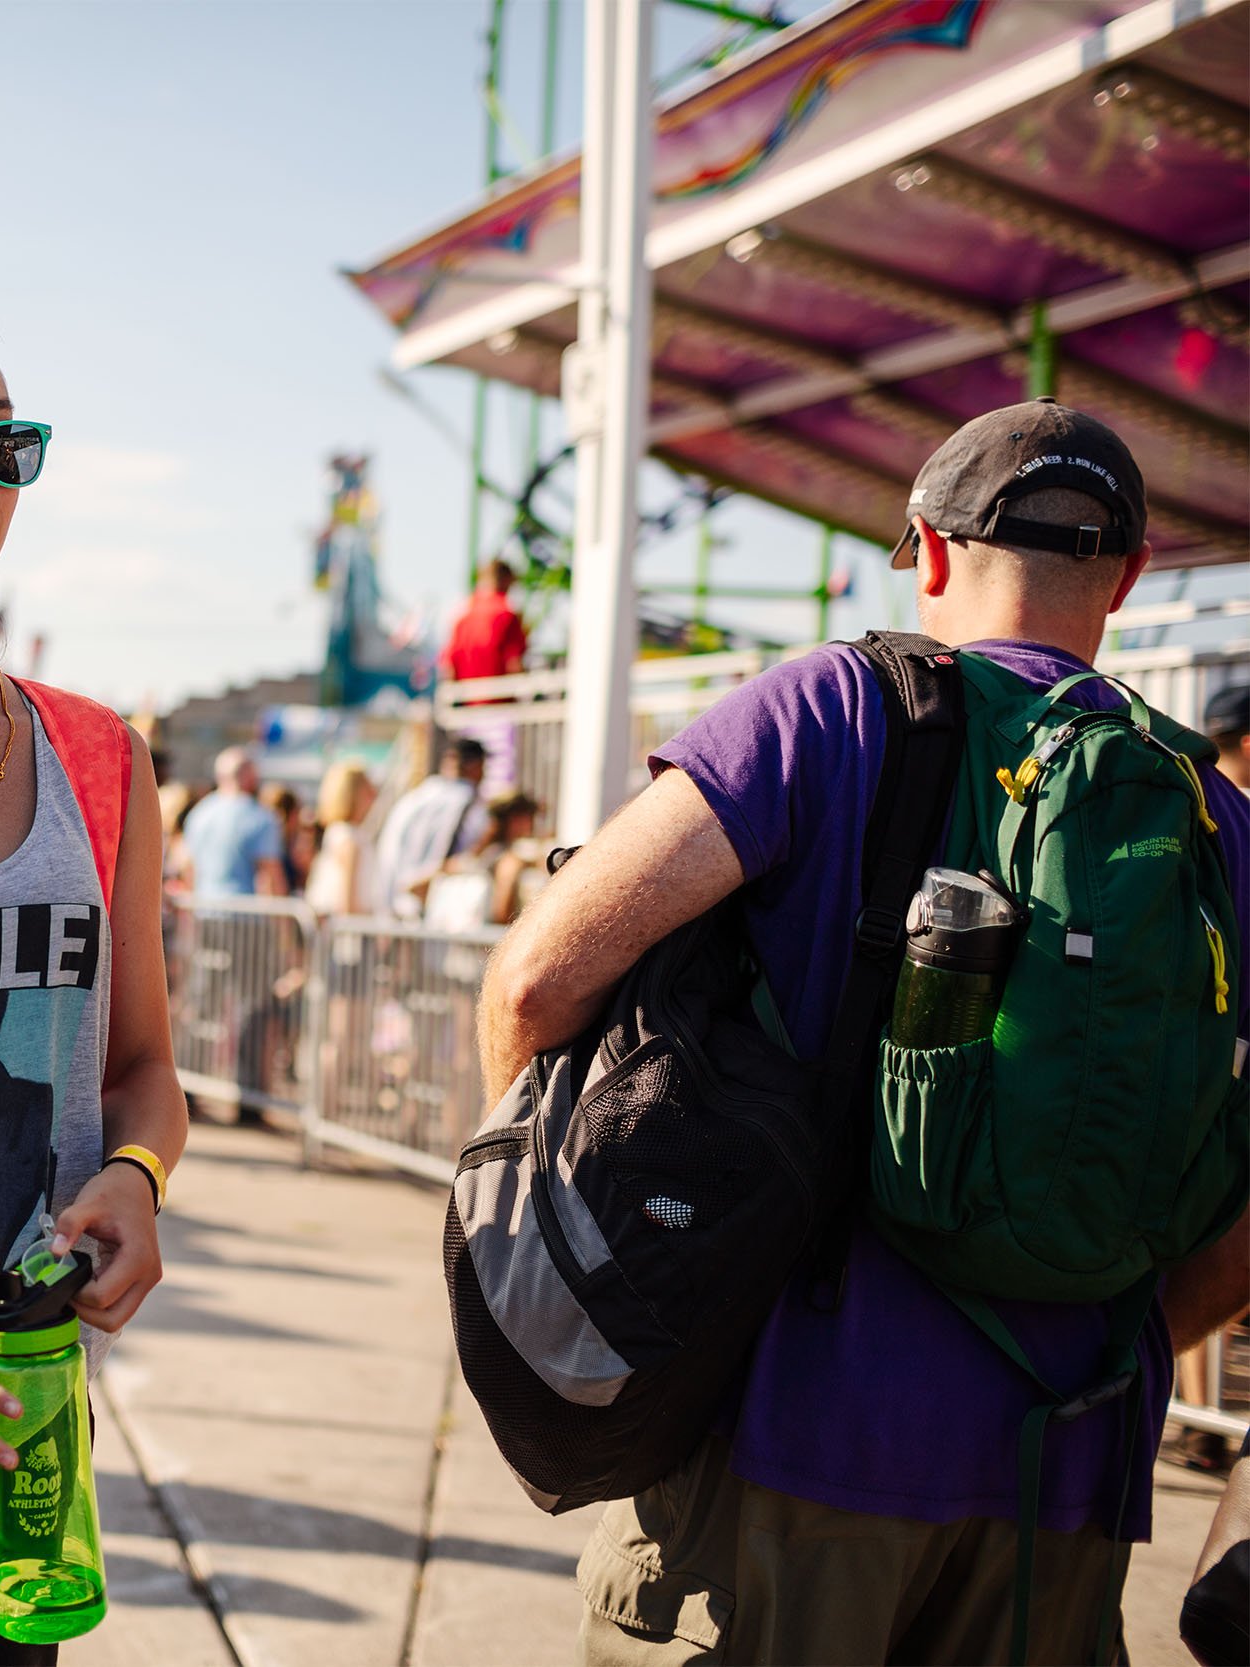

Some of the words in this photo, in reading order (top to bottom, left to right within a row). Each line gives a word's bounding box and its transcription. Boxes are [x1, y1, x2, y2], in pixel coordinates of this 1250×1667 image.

[1091, 462, 1108, 477] LIKE
[1105, 473, 1119, 492] HELL
[1132, 837, 1180, 847] MOUNTAIN
[1132, 844, 1182, 855] EQUIPMENT
[1132, 850, 1164, 858] CO-OP
